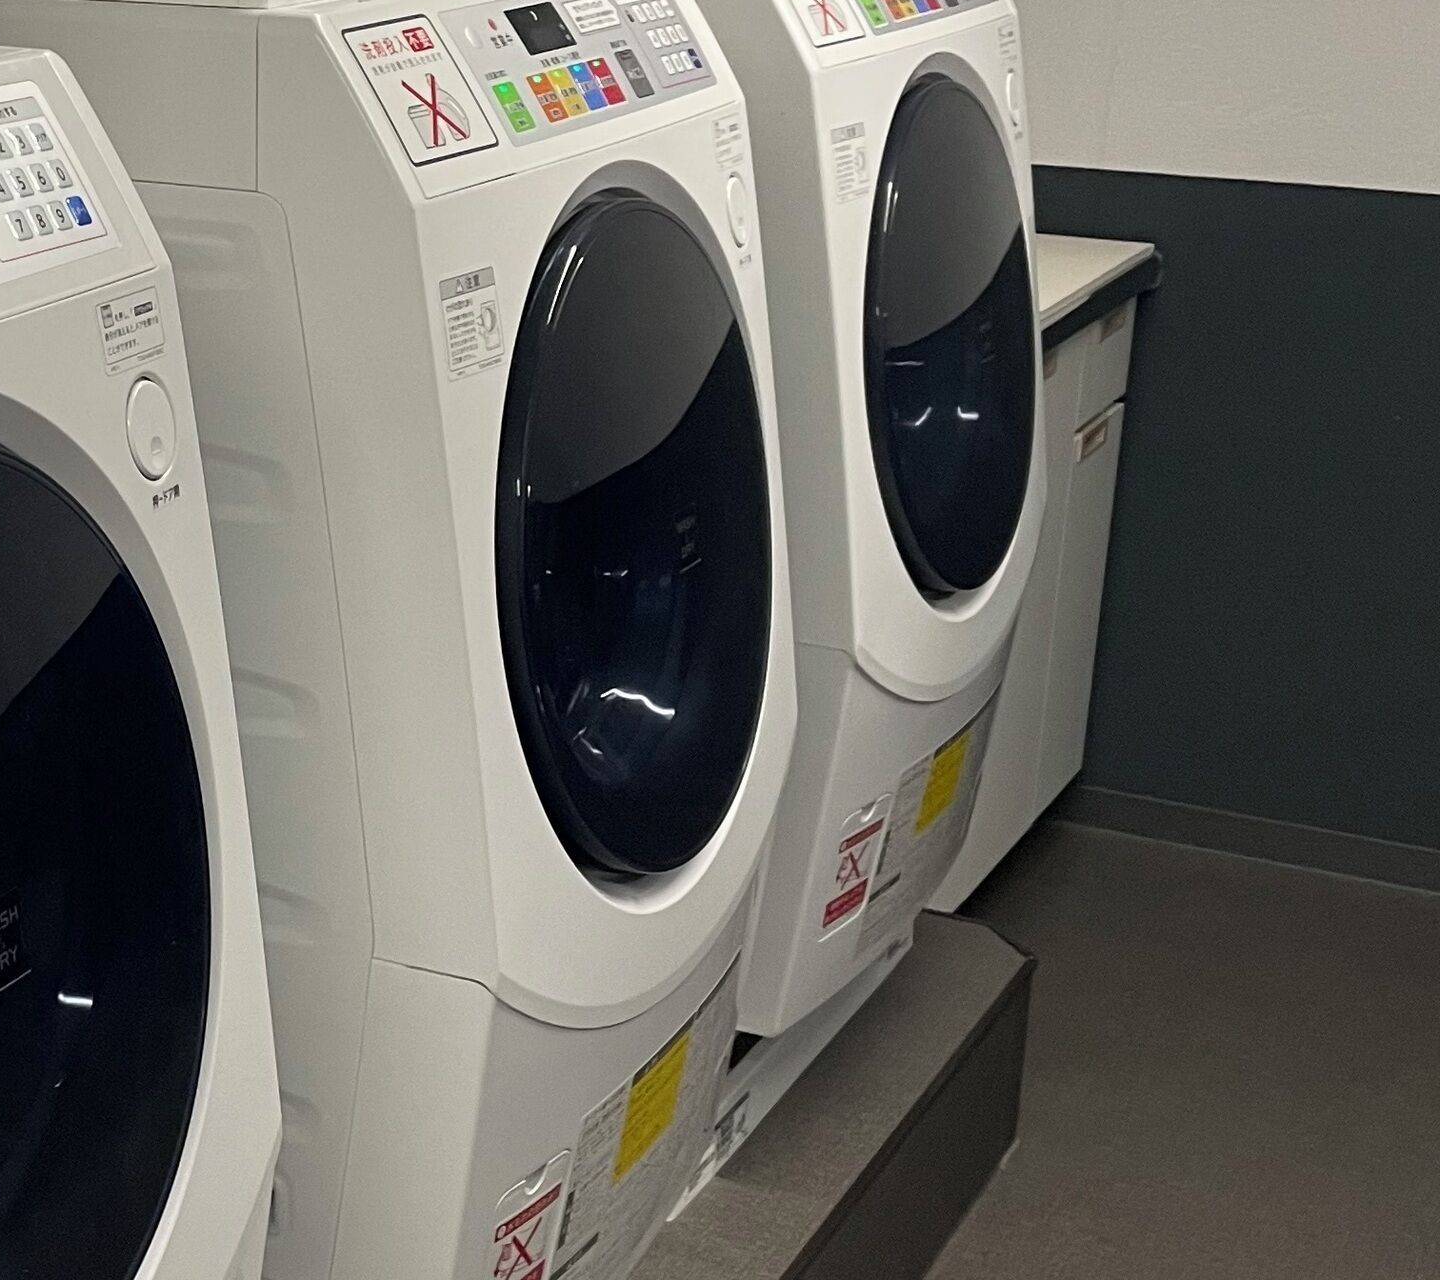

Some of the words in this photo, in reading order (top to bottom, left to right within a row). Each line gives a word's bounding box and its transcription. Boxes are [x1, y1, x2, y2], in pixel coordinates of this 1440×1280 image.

[15, 135, 25, 149] 3
[16, 176, 26, 190] 5
[38, 171, 46, 185] 6
[56, 167, 65, 181] 0
[15, 219, 24, 233] 7
[36, 214, 46, 228] 8
[56, 209, 64, 223] 9
